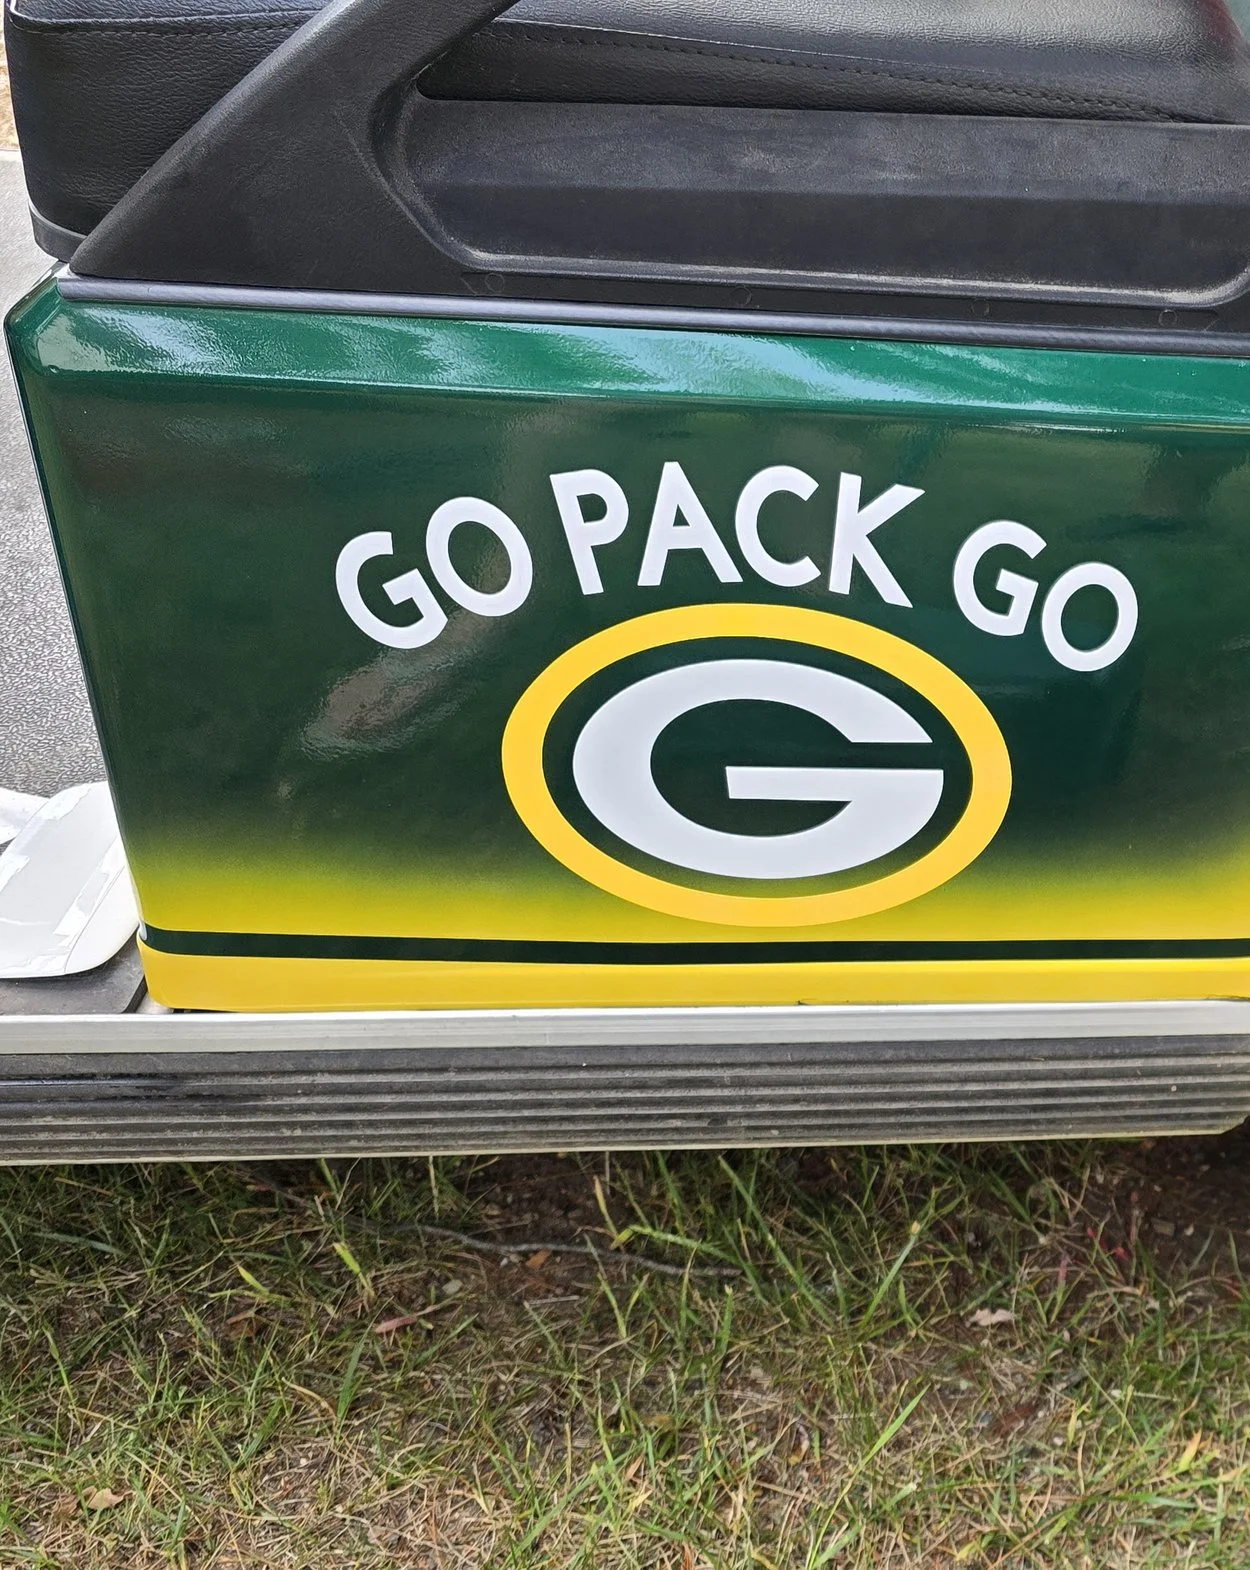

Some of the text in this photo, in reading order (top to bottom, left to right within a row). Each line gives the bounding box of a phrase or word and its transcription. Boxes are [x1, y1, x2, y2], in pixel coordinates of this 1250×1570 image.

[335, 461, 1139, 672] GO PACK GO
[572, 658, 944, 880] G
